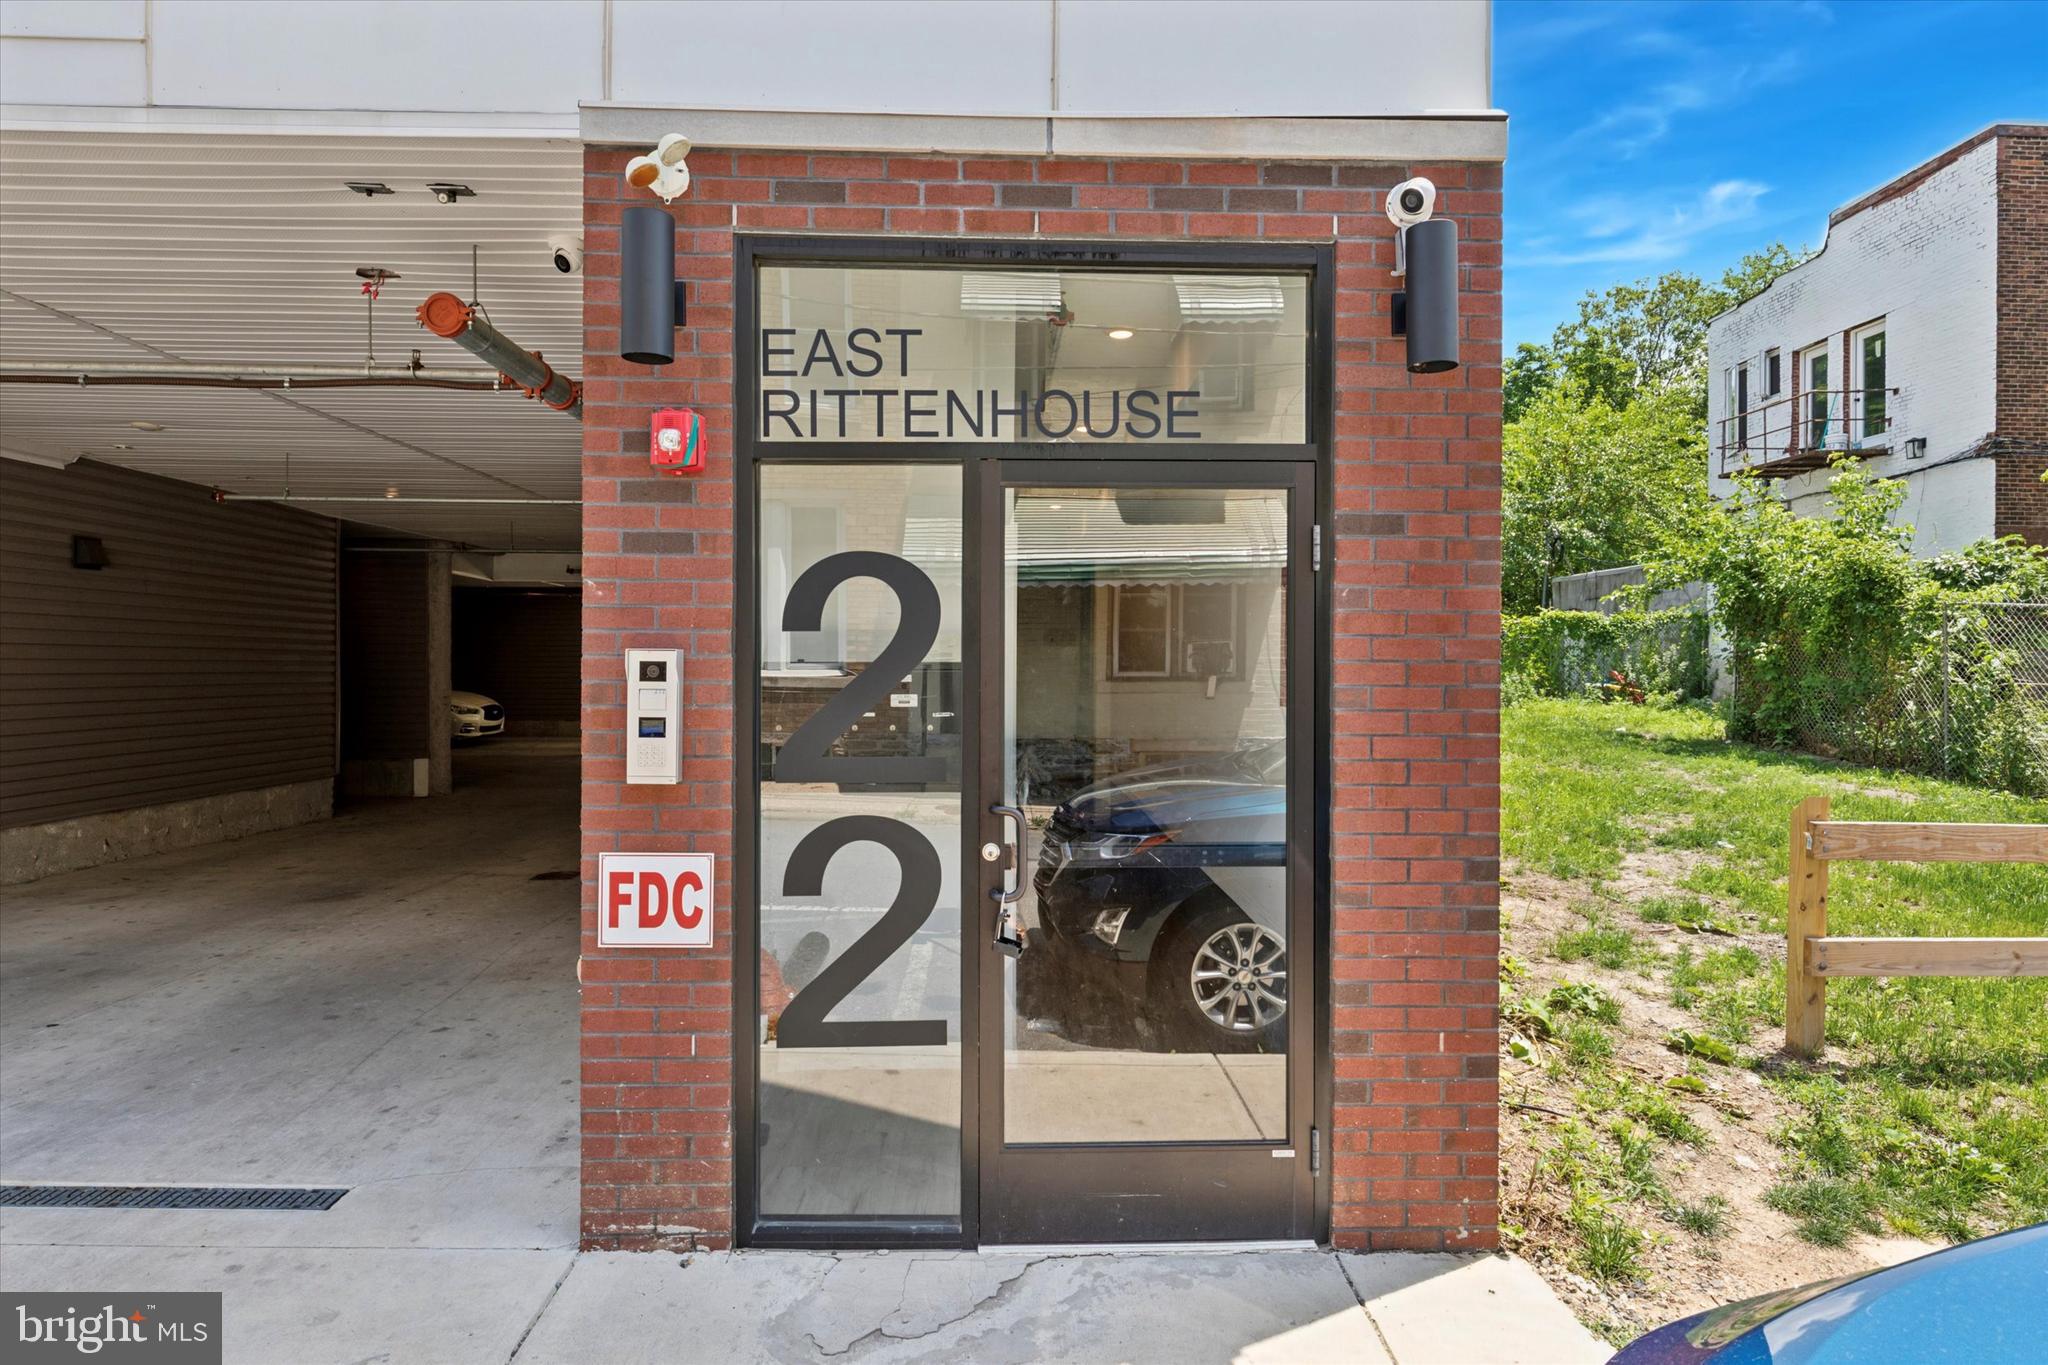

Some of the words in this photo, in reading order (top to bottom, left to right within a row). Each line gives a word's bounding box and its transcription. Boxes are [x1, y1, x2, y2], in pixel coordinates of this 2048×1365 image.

[761, 328, 923, 377] EAST
[761, 389, 1201, 440] RITTENHOUSE
[608, 871, 704, 930] FDC
